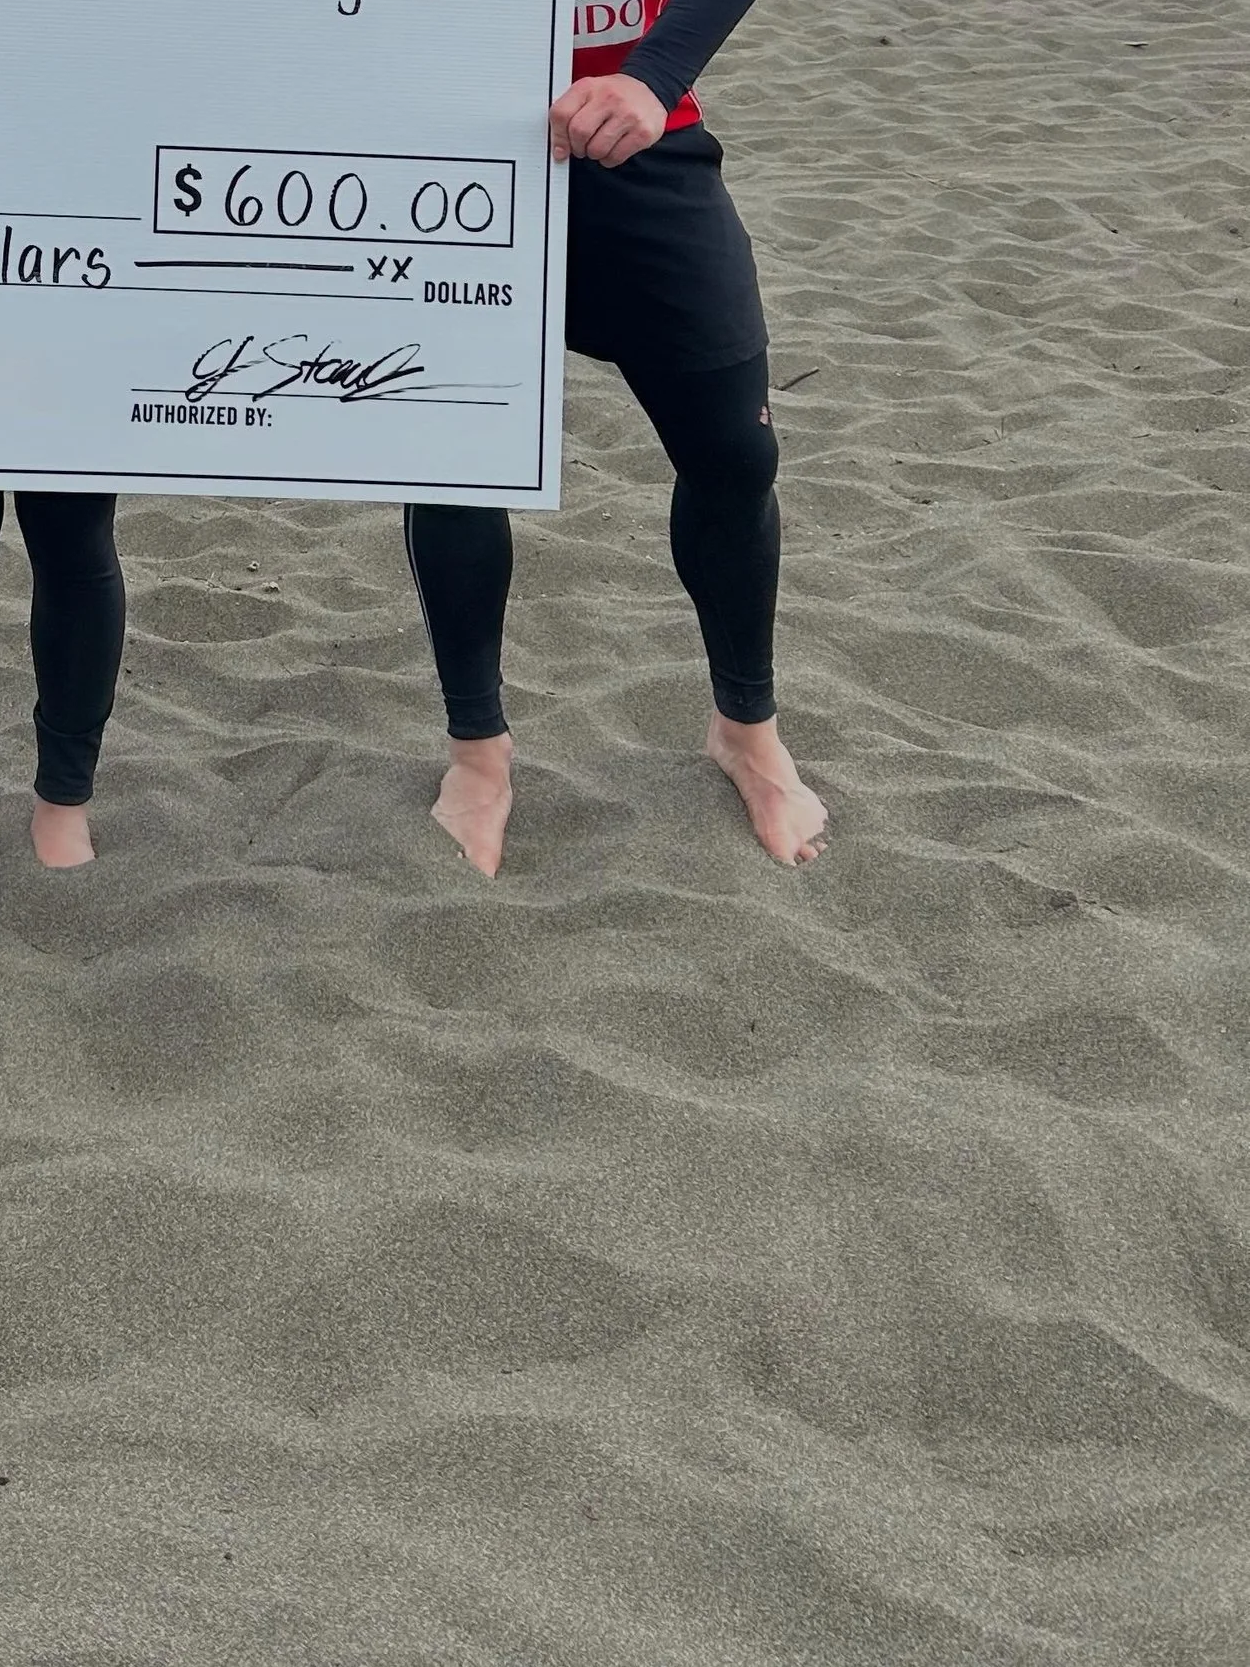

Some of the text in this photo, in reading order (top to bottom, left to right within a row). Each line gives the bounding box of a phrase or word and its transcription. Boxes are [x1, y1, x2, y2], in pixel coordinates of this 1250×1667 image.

[173, 163, 203, 217] $
[224, 164, 495, 234] 600.00
[424, 280, 513, 307] DOLLARS
[130, 403, 273, 427] AUTHORIZED BY:
